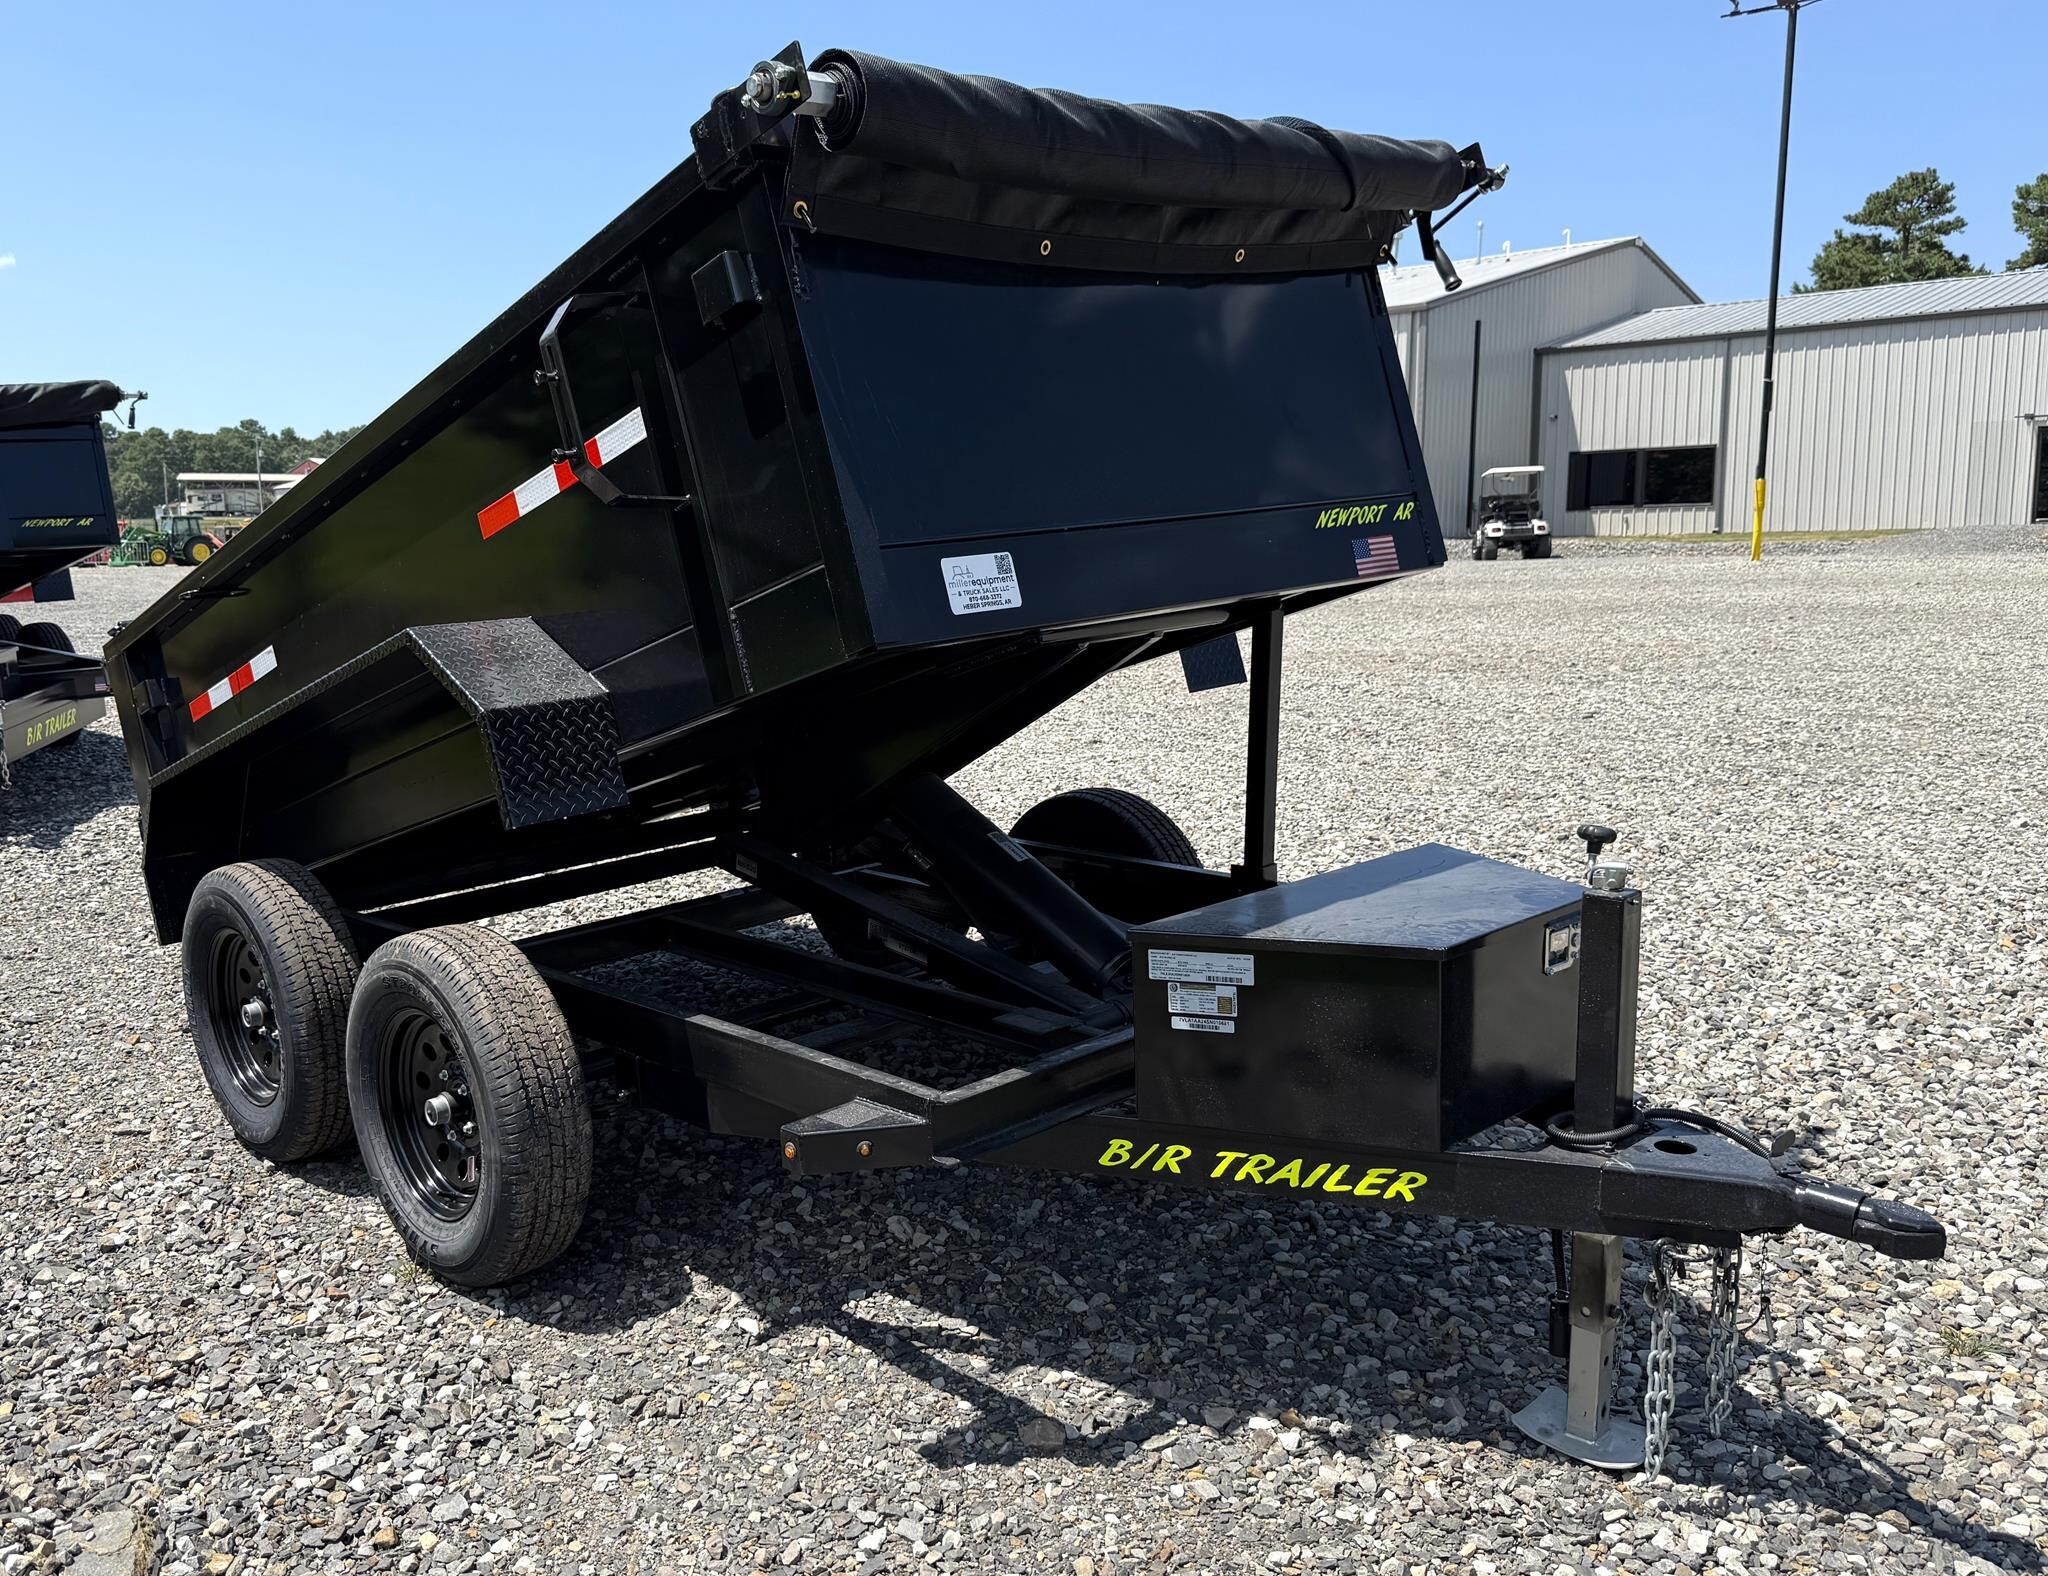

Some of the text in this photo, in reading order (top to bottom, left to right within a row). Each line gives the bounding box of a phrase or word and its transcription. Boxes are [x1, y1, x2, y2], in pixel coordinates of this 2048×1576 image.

[1315, 501, 1415, 528] NEWPORT AR
[21, 517, 94, 528] NEWPORT AR
[948, 574, 1014, 588] millerequipment
[963, 588, 980, 597] TRUCK
[982, 586, 999, 595] SALES
[1000, 585, 1010, 593] LLC
[963, 602, 980, 610] HEBER
[26, 708, 77, 747] B/R TRAILER
[1098, 1138, 1428, 1202] B/R TRAILER
